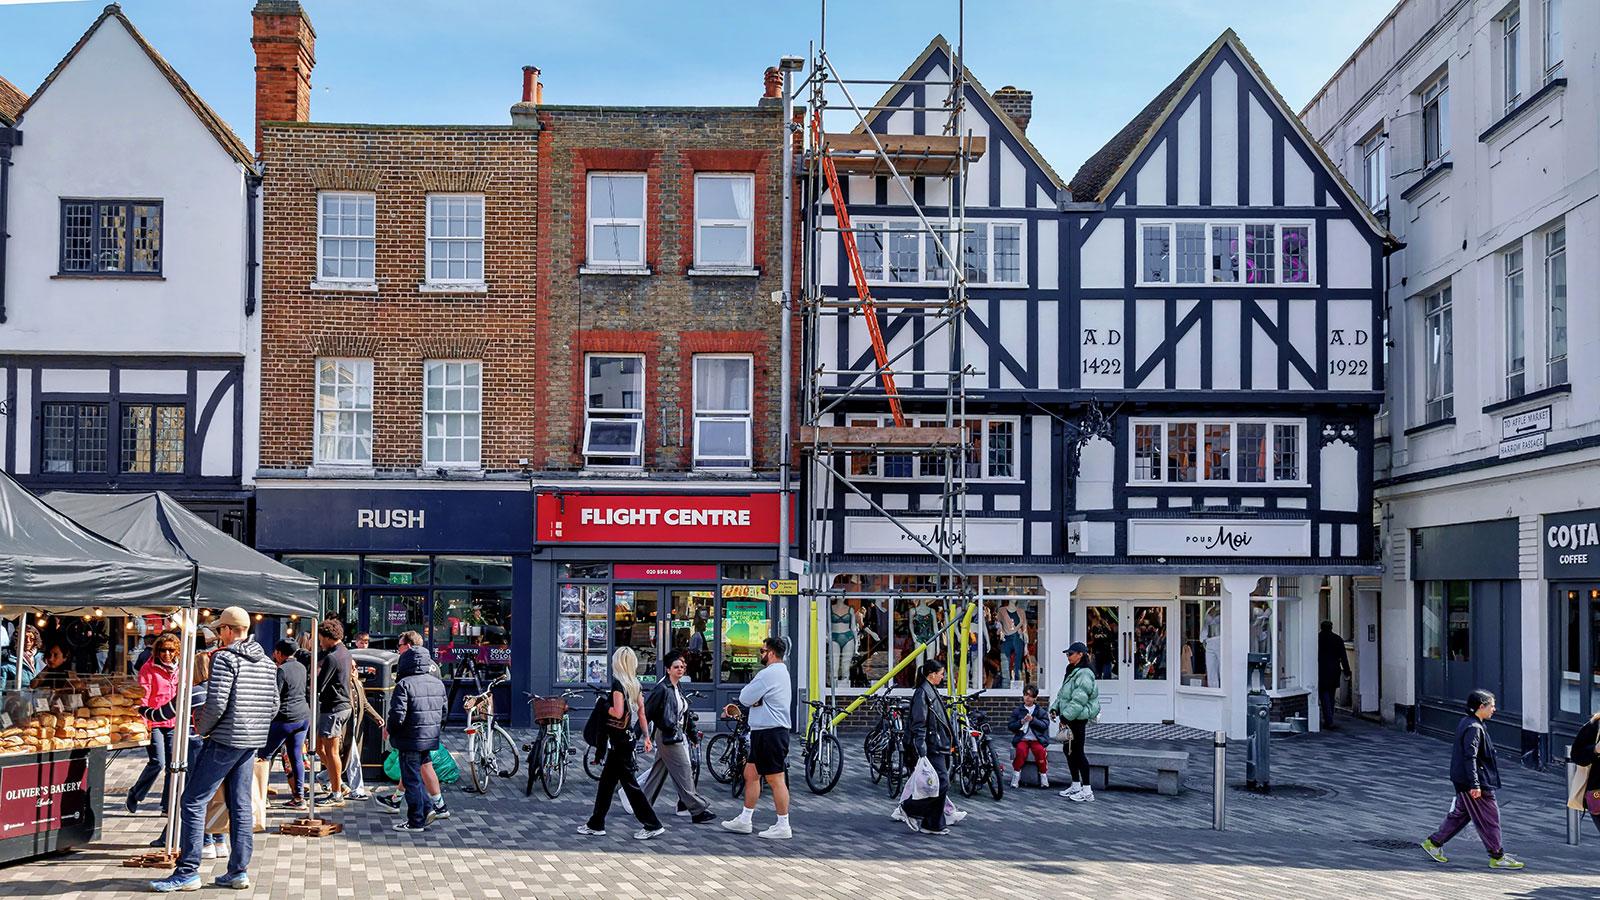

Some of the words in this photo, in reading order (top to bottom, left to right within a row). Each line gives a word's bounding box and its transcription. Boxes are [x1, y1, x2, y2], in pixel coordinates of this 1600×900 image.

[1083, 357, 1121, 374] 1422
[1330, 359, 1368, 376] 1922
[1504, 419, 1511, 428] TO
[1512, 415, 1526, 427] APPLE
[1528, 410, 1549, 422] MARKET
[1522, 437, 1543, 449] PASSAGE
[358, 509, 424, 528] RUSH
[581, 508, 660, 525] FLIGHT
[664, 509, 750, 526] CENTRE
[1206, 526, 1252, 551] Moi
[1548, 523, 1599, 550] COSTA
[1560, 554, 1588, 564] COFFEE
[6, 786, 48, 800] OLIVIER'S
[50, 781, 81, 794] BAKERY
